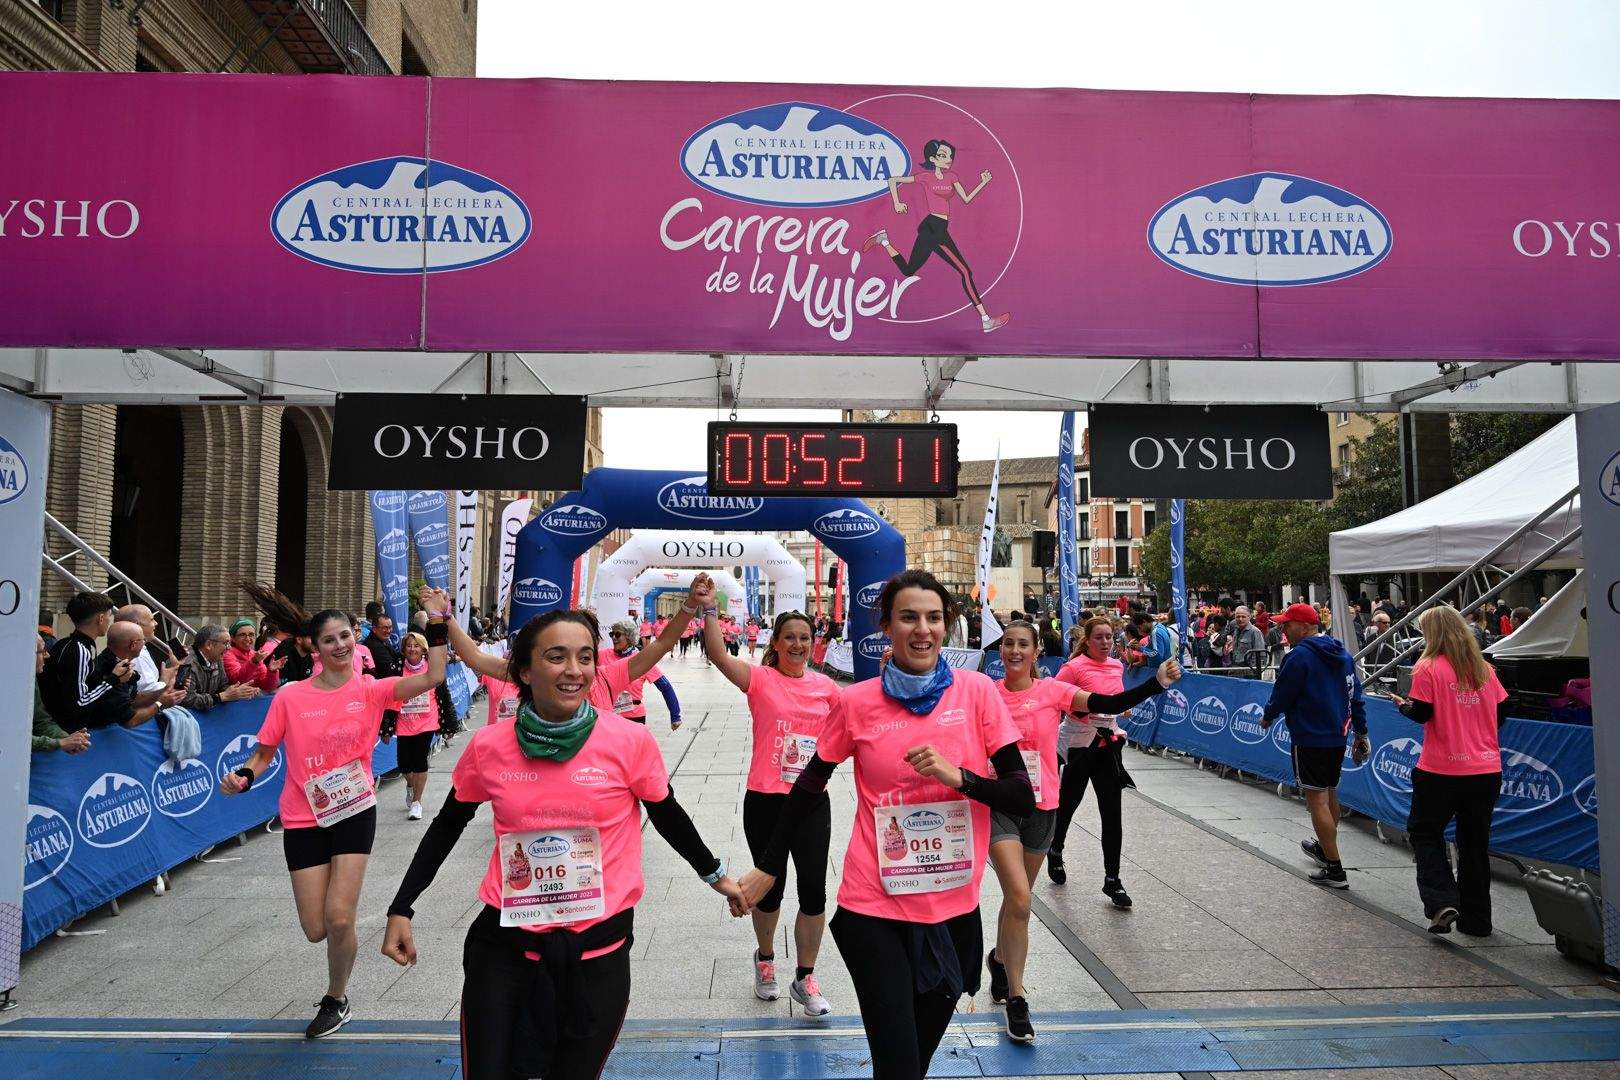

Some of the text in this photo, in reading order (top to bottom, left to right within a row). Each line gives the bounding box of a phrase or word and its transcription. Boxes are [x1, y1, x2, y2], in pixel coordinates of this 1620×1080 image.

[733, 137, 887, 151] CENTRAL LECHERA
[697, 138, 892, 182] ASTURIANA
[332, 197, 504, 209] CENTRAL LECHERA
[290, 198, 512, 243] ASTURIANA
[1204, 211, 1365, 223] CENTRAL LECHERA
[659, 197, 851, 255] Carrera
[1167, 212, 1375, 256] ASTURIANA
[1512, 219, 1620, 258] OYS
[704, 250, 922, 341] de la Mujer
[373, 424, 550, 461] OYSHO
[1128, 436, 1296, 471] OYSHO
[665, 488, 756, 509] ASTURIANA
[544, 514, 602, 529] ASTURIANA
[820, 521, 876, 532] ASTURIANA
[662, 540, 744, 558] OYSHO
[612, 559, 638, 567] OYSHO
[766, 559, 791, 567] OYSHO
[600, 591, 624, 599] OYSHO
[779, 592, 803, 600] OYSHO
[1193, 706, 1226, 727] ASTURIANA
[776, 719, 792, 732] TU
[305, 753, 325, 769] TU
[499, 771, 539, 782] OYSHO
[156, 776, 211, 807] ASTURIANA
[330, 785, 351, 801] 016
[85, 797, 150, 839] ASTURIANA
[906, 819, 942, 828] ASTURIANA
[531, 844, 568, 855] ASTURIANA
[909, 837, 943, 852] 016
[915, 854, 941, 864] 12554
[534, 864, 567, 881] 016
[538, 882, 565, 894] 12493
[889, 879, 919, 888] OYSHO
[512, 897, 541, 905] CARRERA
[550, 895, 558, 903] LA
[558, 893, 579, 901] MUJER
[509, 909, 542, 920] OYSHO
